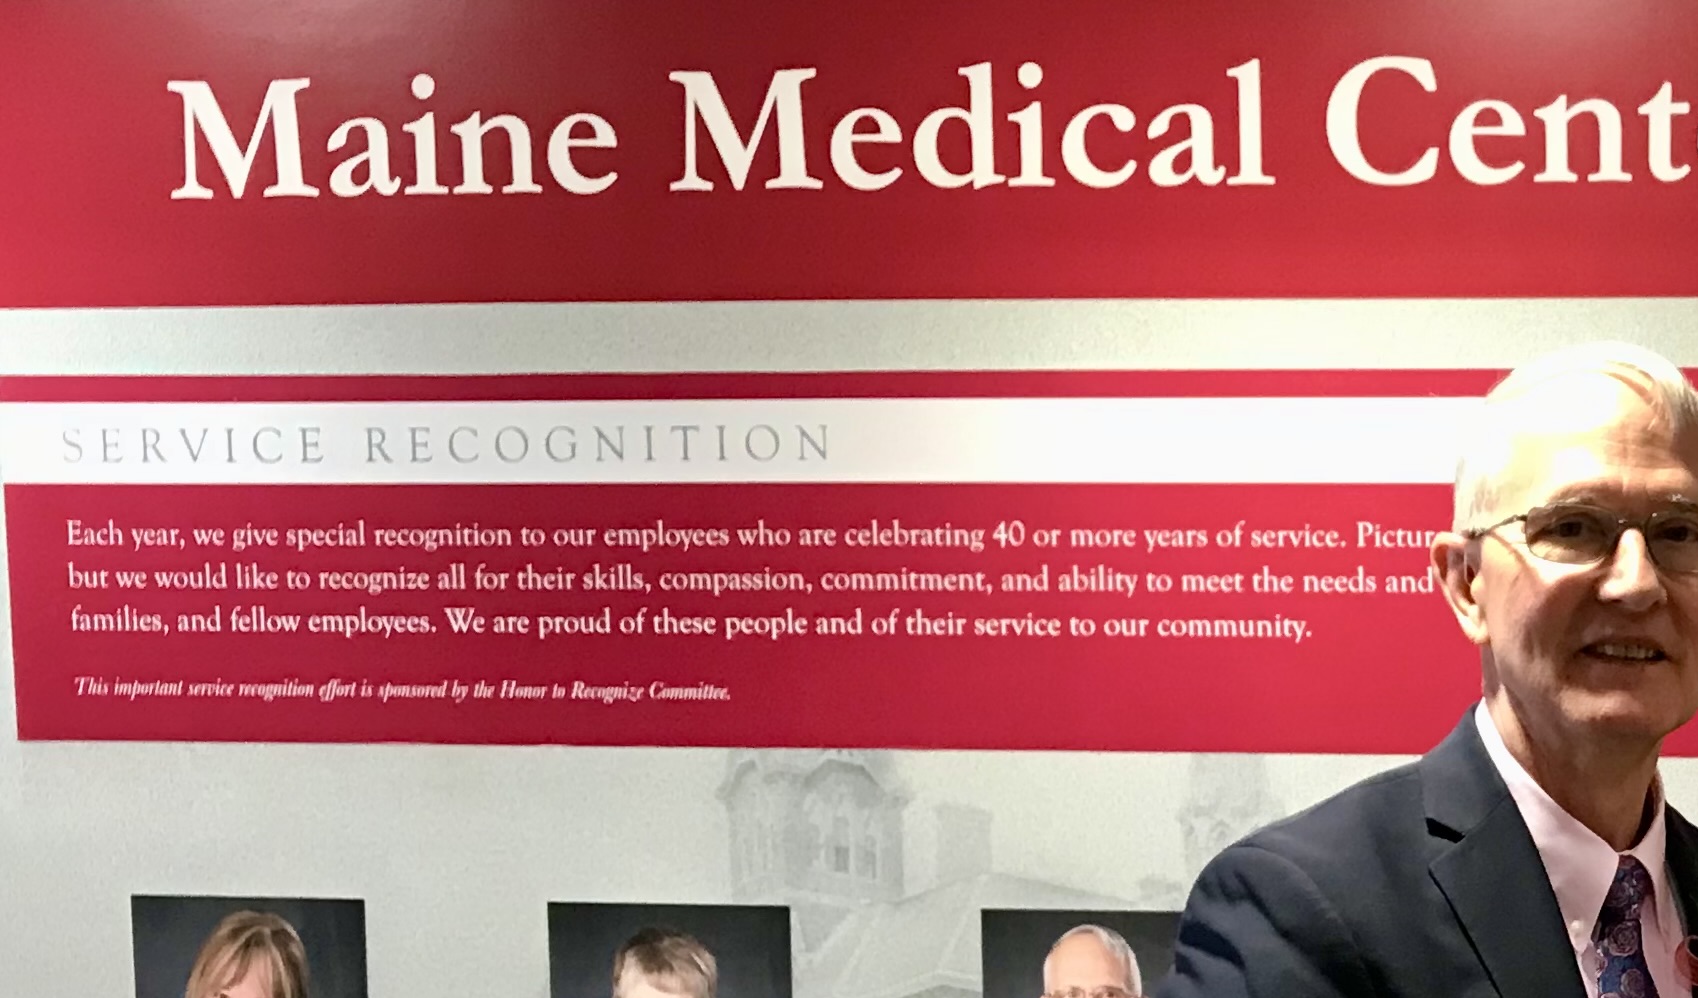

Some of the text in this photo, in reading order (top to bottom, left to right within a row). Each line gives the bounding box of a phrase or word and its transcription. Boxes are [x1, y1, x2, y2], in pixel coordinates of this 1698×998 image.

[167, 74, 618, 199] Maine
[669, 59, 1275, 191] Medical
[63, 425, 827, 464] SERVICE RECOGNITION
[67, 519, 123, 545] Each
[131, 528, 185, 551] year,
[193, 528, 224, 546] we
[232, 523, 278, 551] give
[286, 520, 366, 552] special
[374, 523, 512, 552] recognition
[521, 527, 545, 546] to
[553, 529, 596, 546] our
[604, 519, 730, 552] employees
[737, 519, 791, 546] who
[799, 529, 836, 546] are
[844, 519, 985, 552] celebrating
[992, 520, 1025, 548] 40
[1033, 529, 1061, 547] or
[1070, 529, 1136, 547] more
[1144, 530, 1208, 553] years
[1216, 520, 1245, 547] of
[1251, 524, 1346, 548] service.
[1357, 521, 1436, 548] Pictur
[68, 561, 109, 588] but
[116, 571, 147, 589] we
[154, 562, 227, 589] would
[236, 562, 278, 589] like
[287, 570, 310, 589] to
[319, 566, 429, 595] recognize
[438, 563, 466, 589] all
[475, 563, 509, 590] for
[517, 563, 576, 590] their
[583, 563, 651, 593] skills,
[659, 567, 812, 596] compassion,
[821, 567, 992, 595] commitment,
[1001, 564, 1049, 591] and
[1058, 564, 1138, 598] ability
[1146, 573, 1173, 592] to
[1181, 573, 1244, 593] meet
[1252, 565, 1294, 593] the
[1303, 565, 1377, 593] needs
[1385, 566, 1434, 594] and
[71, 604, 1312, 643] families, and fellow employees. We are proud of these people and of their service to our community.
[74, 676, 730, 704] This important service recognition effort is sponsored by the Honor to Recognize Committee.
